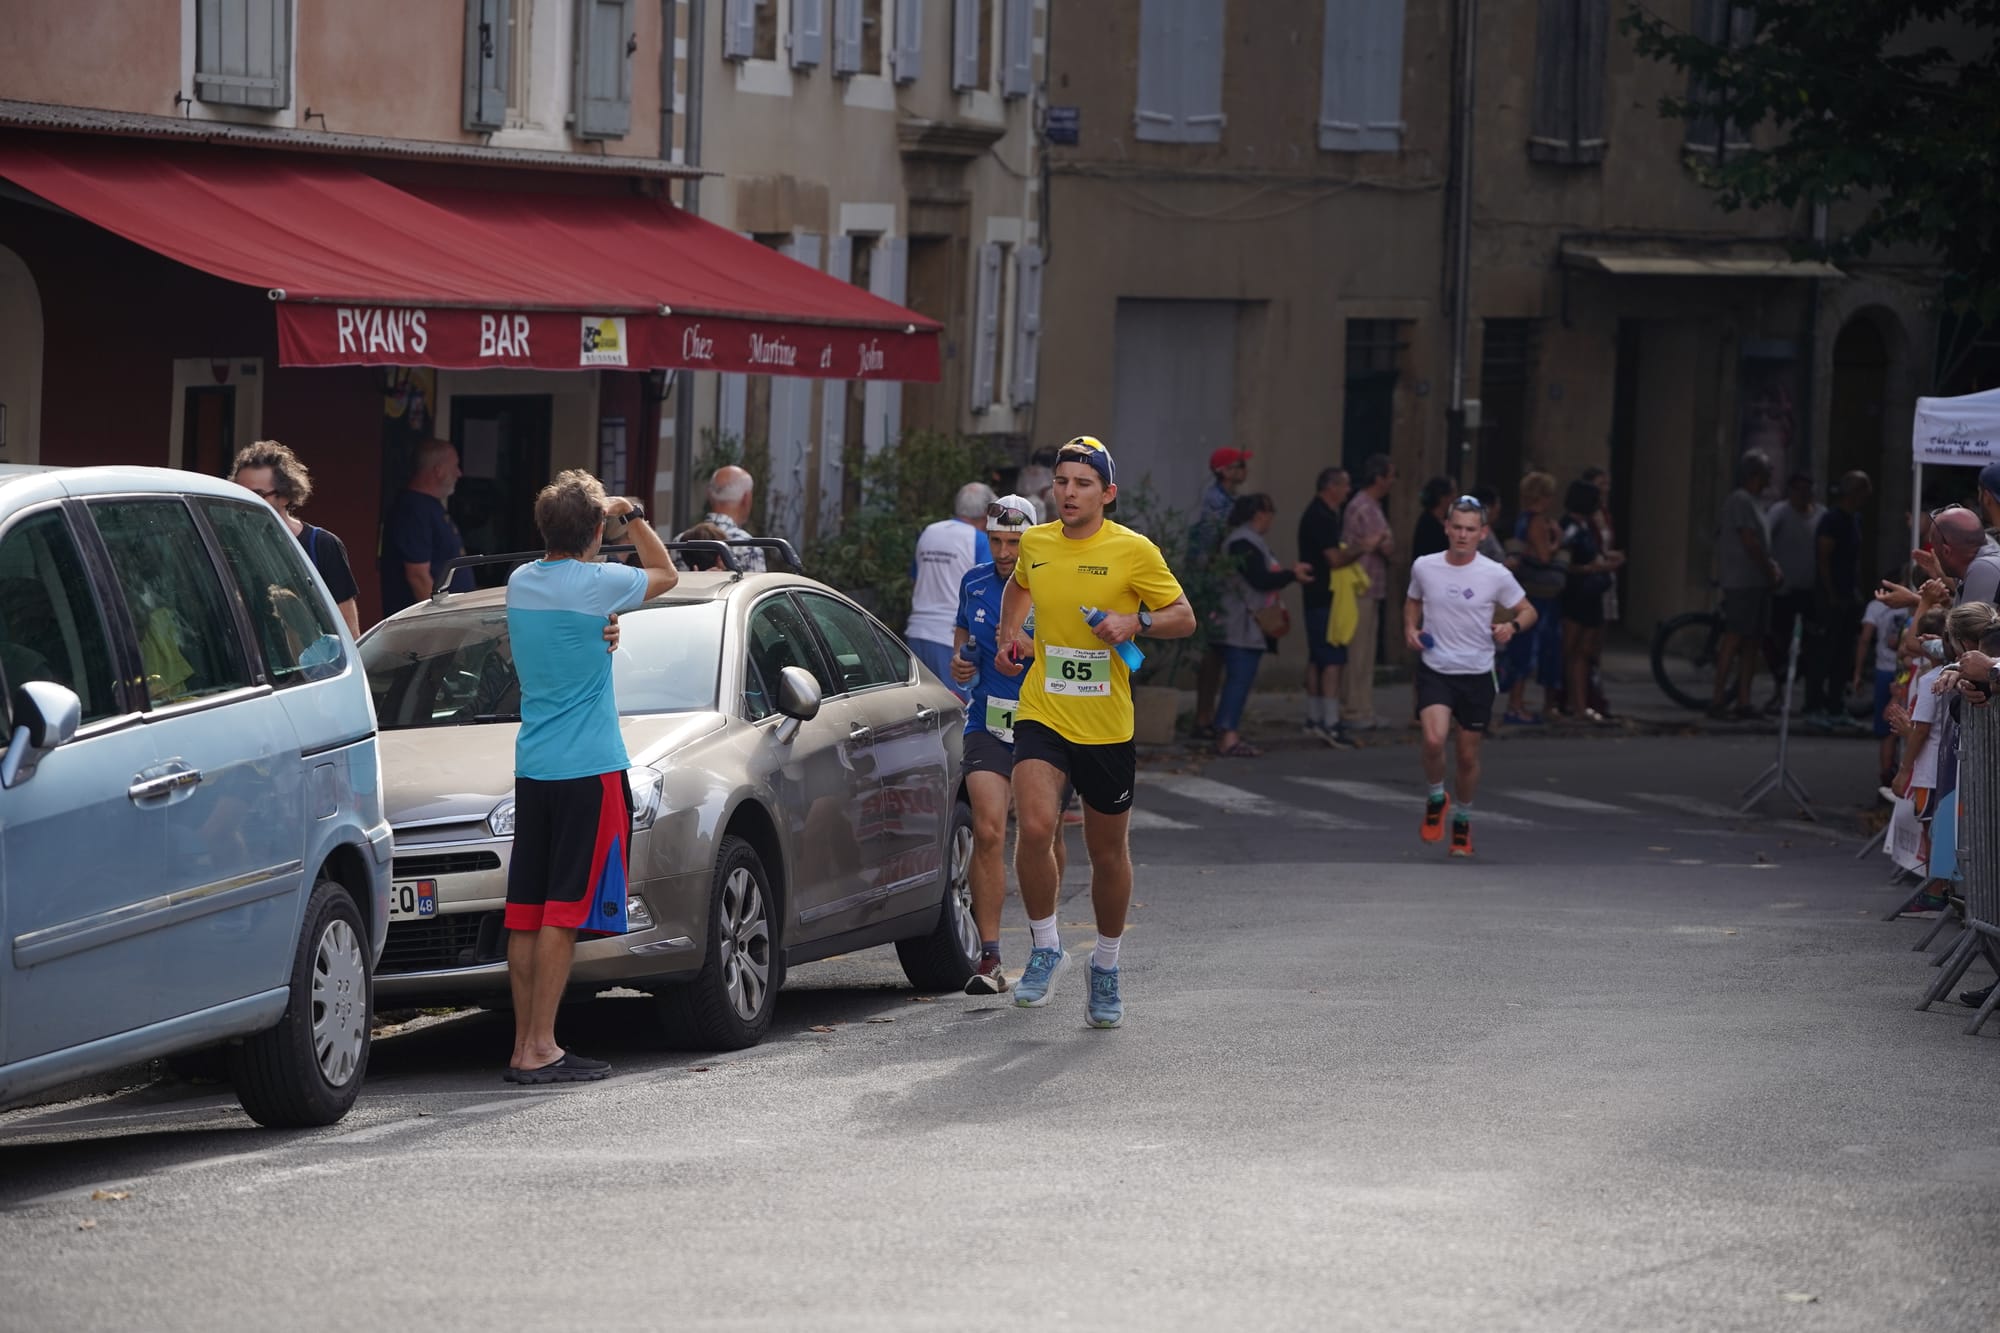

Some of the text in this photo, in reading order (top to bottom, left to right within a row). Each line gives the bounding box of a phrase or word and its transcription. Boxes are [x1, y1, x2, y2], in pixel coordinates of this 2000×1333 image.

[336, 308, 531, 357] RYAN'S BAR
[682, 323, 884, 376] Chez Martine et John
[1062, 660, 1092, 681] 65
[420, 899, 433, 912] 48
